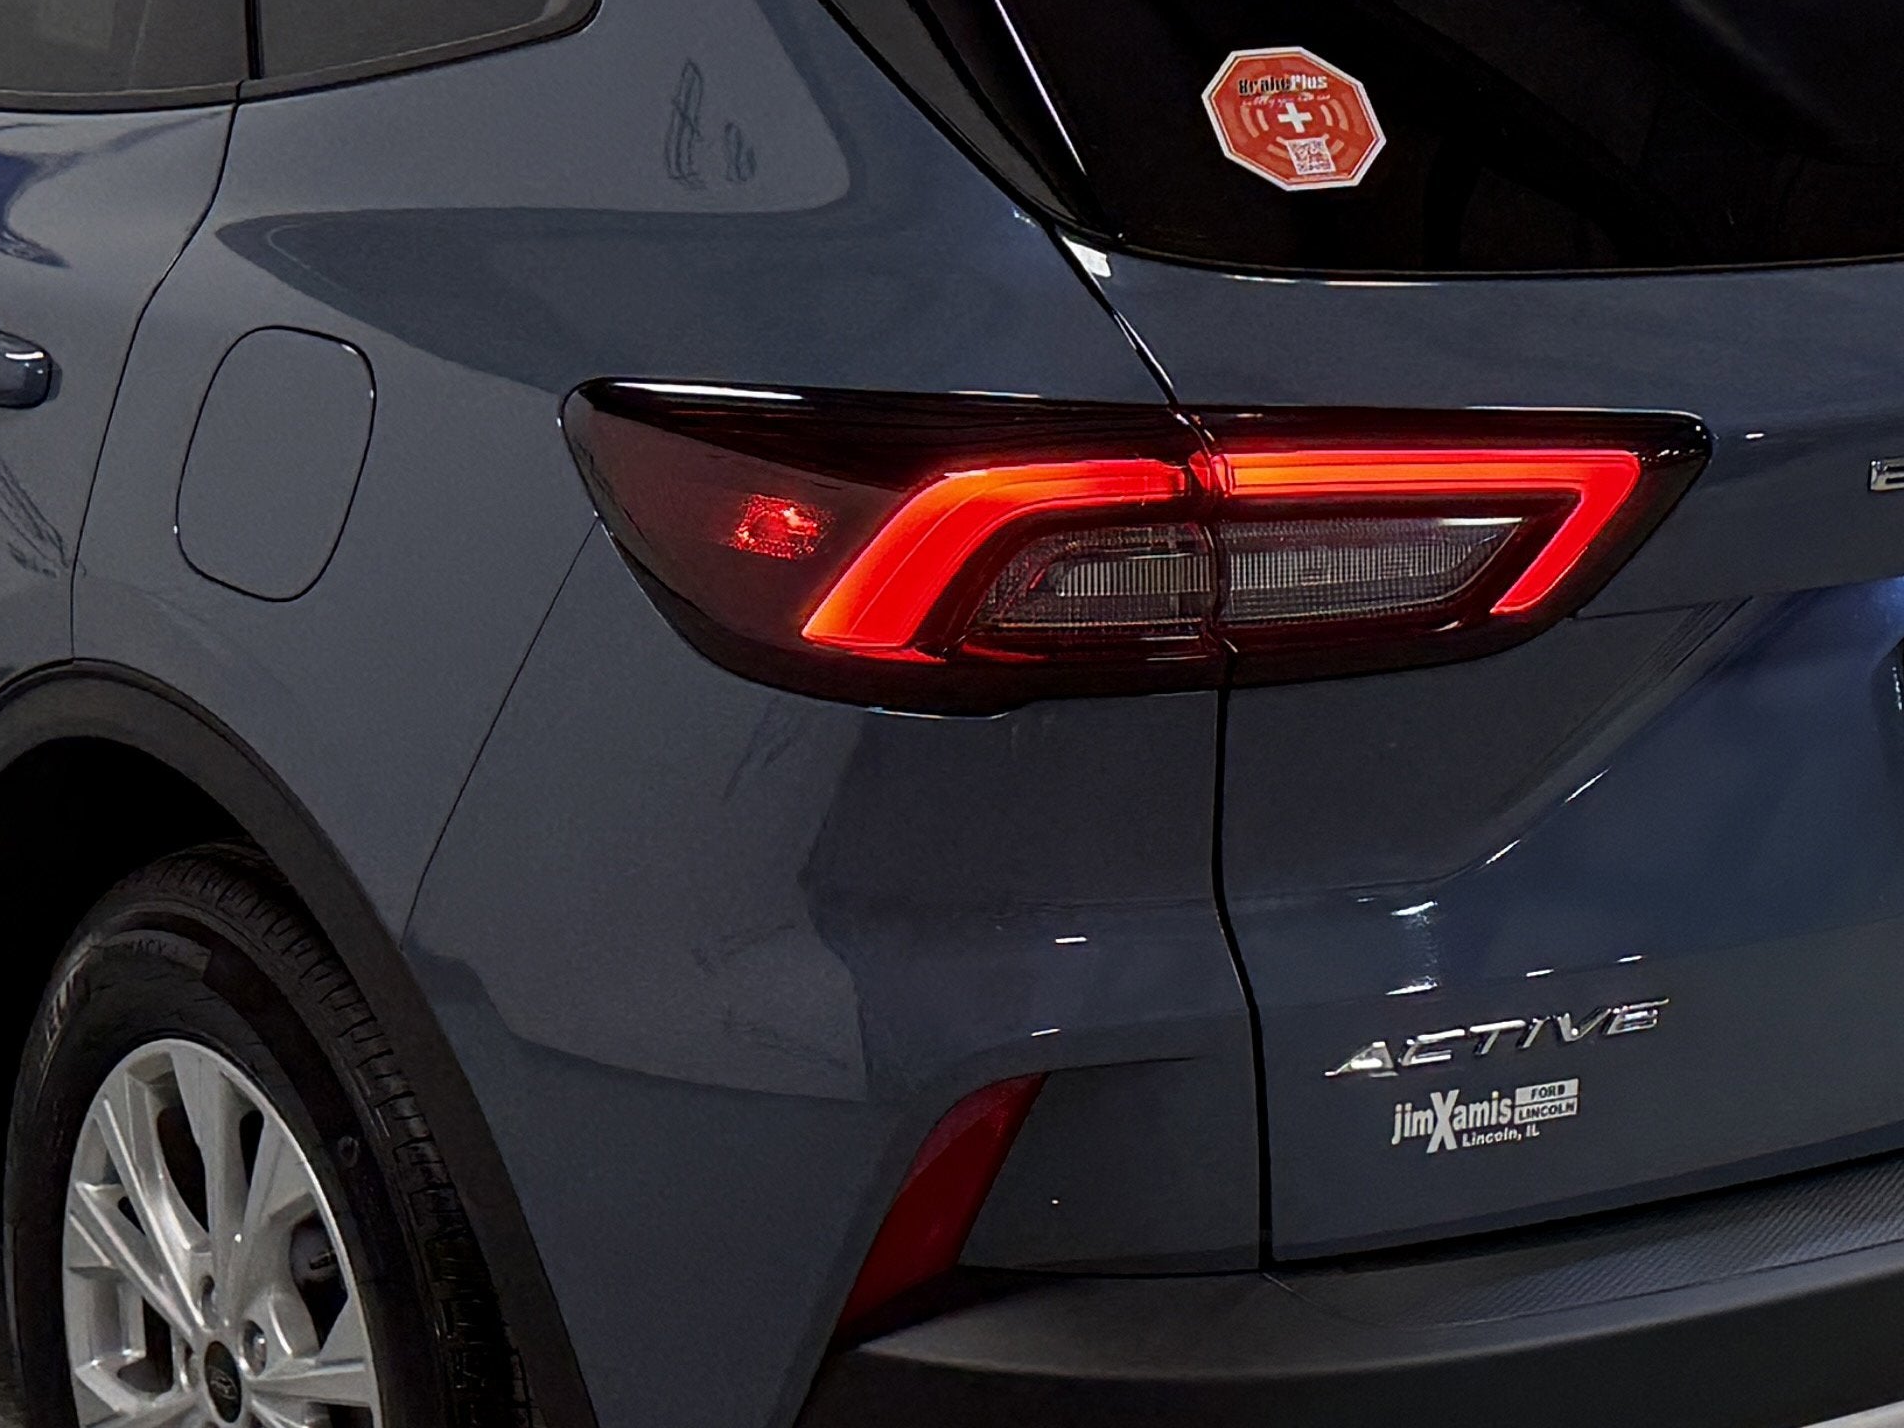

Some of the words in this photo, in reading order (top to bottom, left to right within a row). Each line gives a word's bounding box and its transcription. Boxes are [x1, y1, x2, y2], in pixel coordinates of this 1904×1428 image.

[1324, 998, 1669, 1078] ACTIVE
[1531, 1085, 1565, 1100] FORD
[1518, 1101, 1575, 1121] LINCOLN
[1462, 1128, 1522, 1147] Lincoln,
[1526, 1124, 1540, 1137] IL
